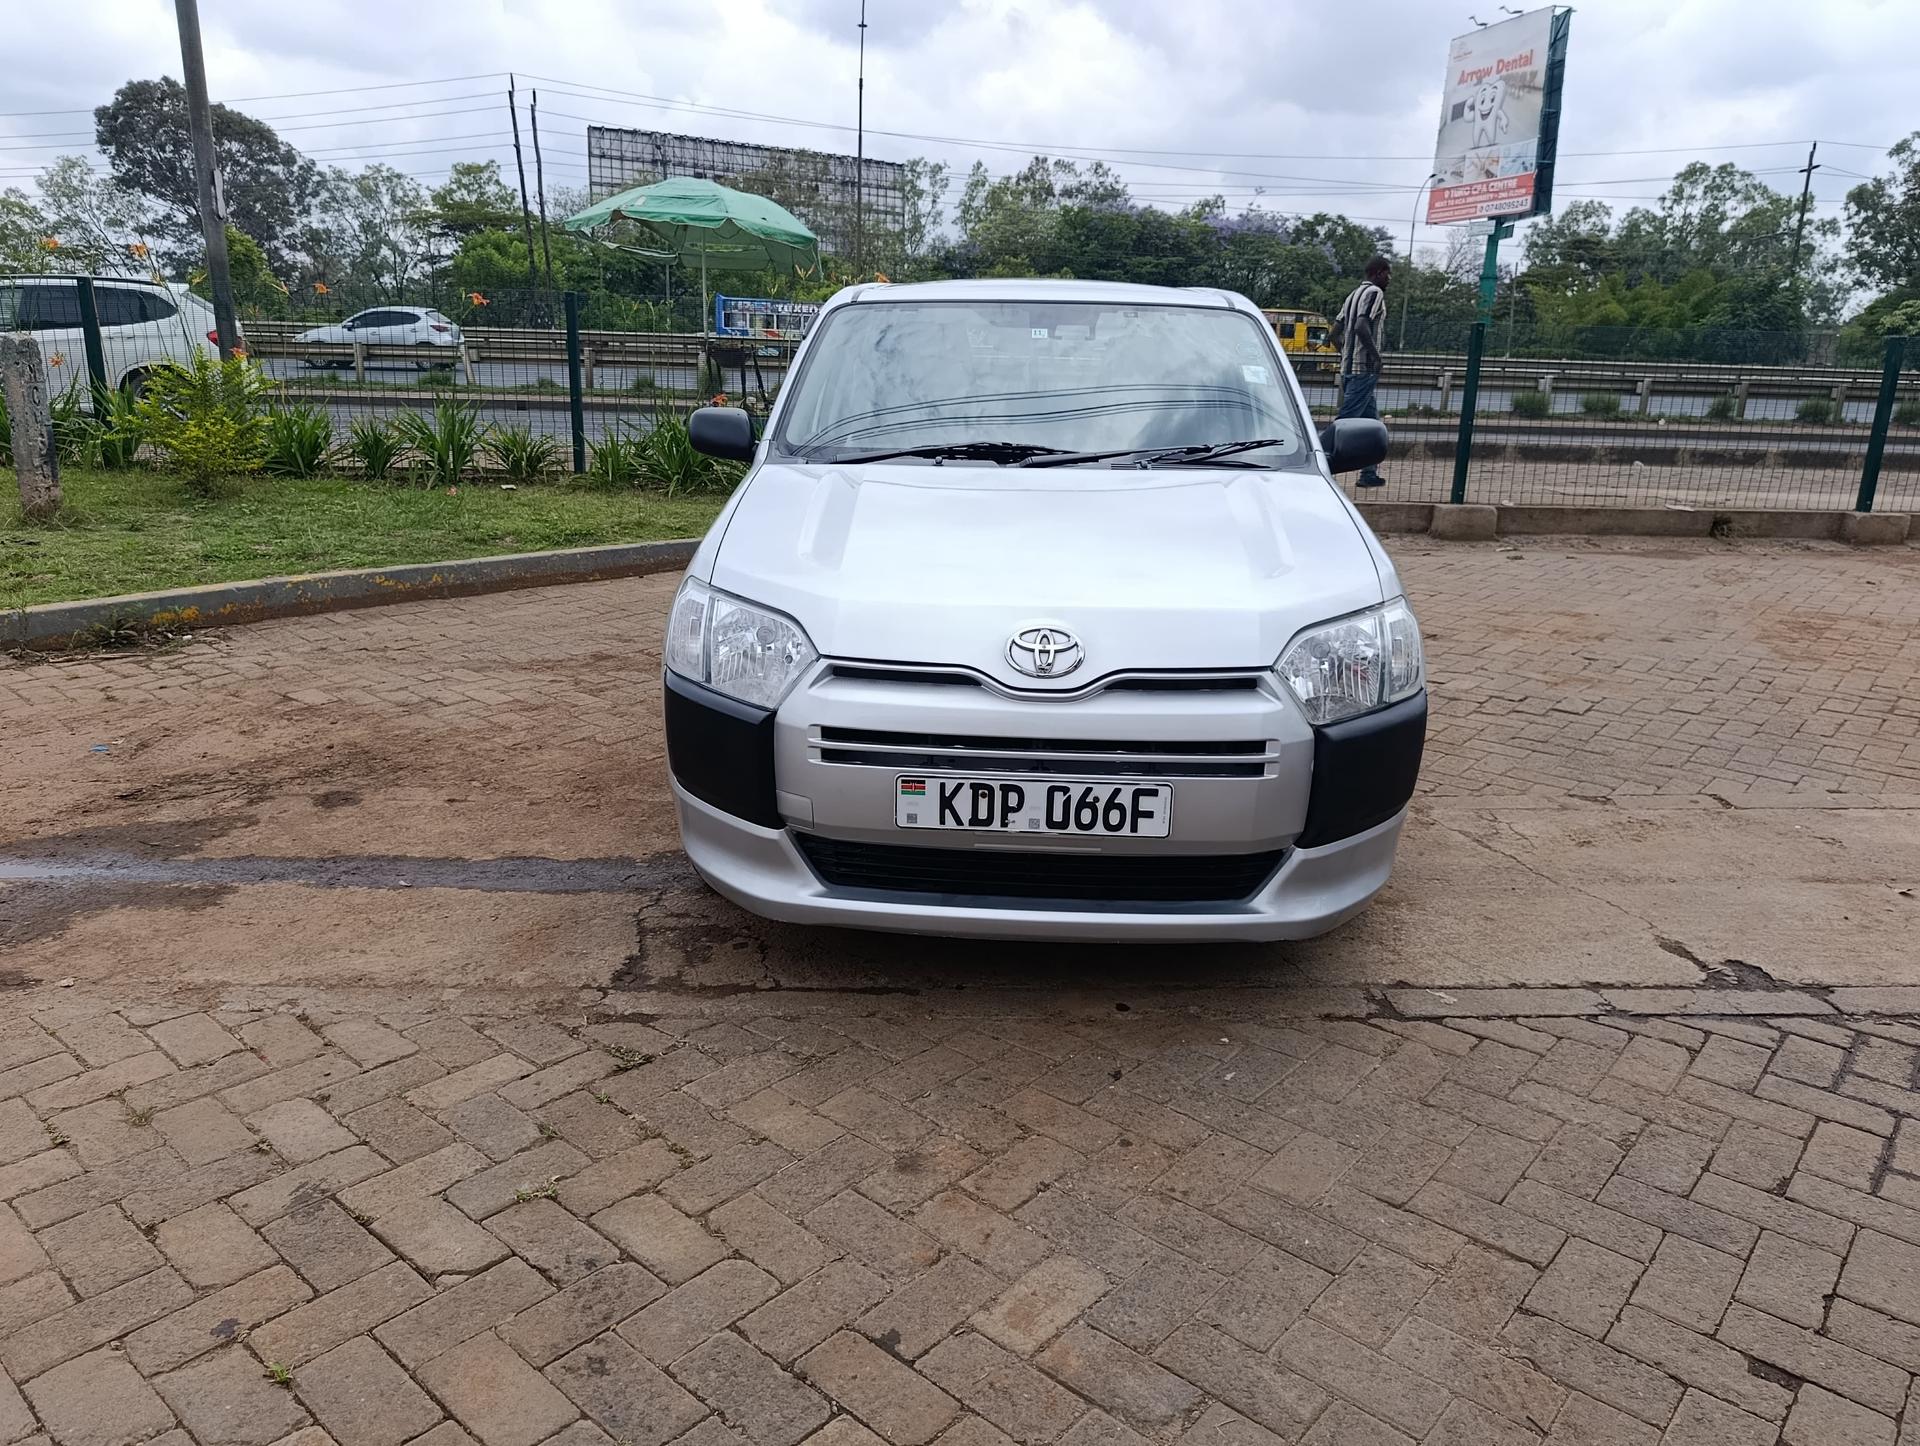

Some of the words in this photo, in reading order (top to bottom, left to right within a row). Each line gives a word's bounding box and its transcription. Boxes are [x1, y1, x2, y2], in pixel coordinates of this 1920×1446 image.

[1457, 65, 1493, 86] Arrow
[1496, 48, 1534, 74] Dental
[1488, 179, 1518, 192] CENTRE
[939, 781, 1026, 828] KDP
[1045, 784, 1159, 834] 066F
